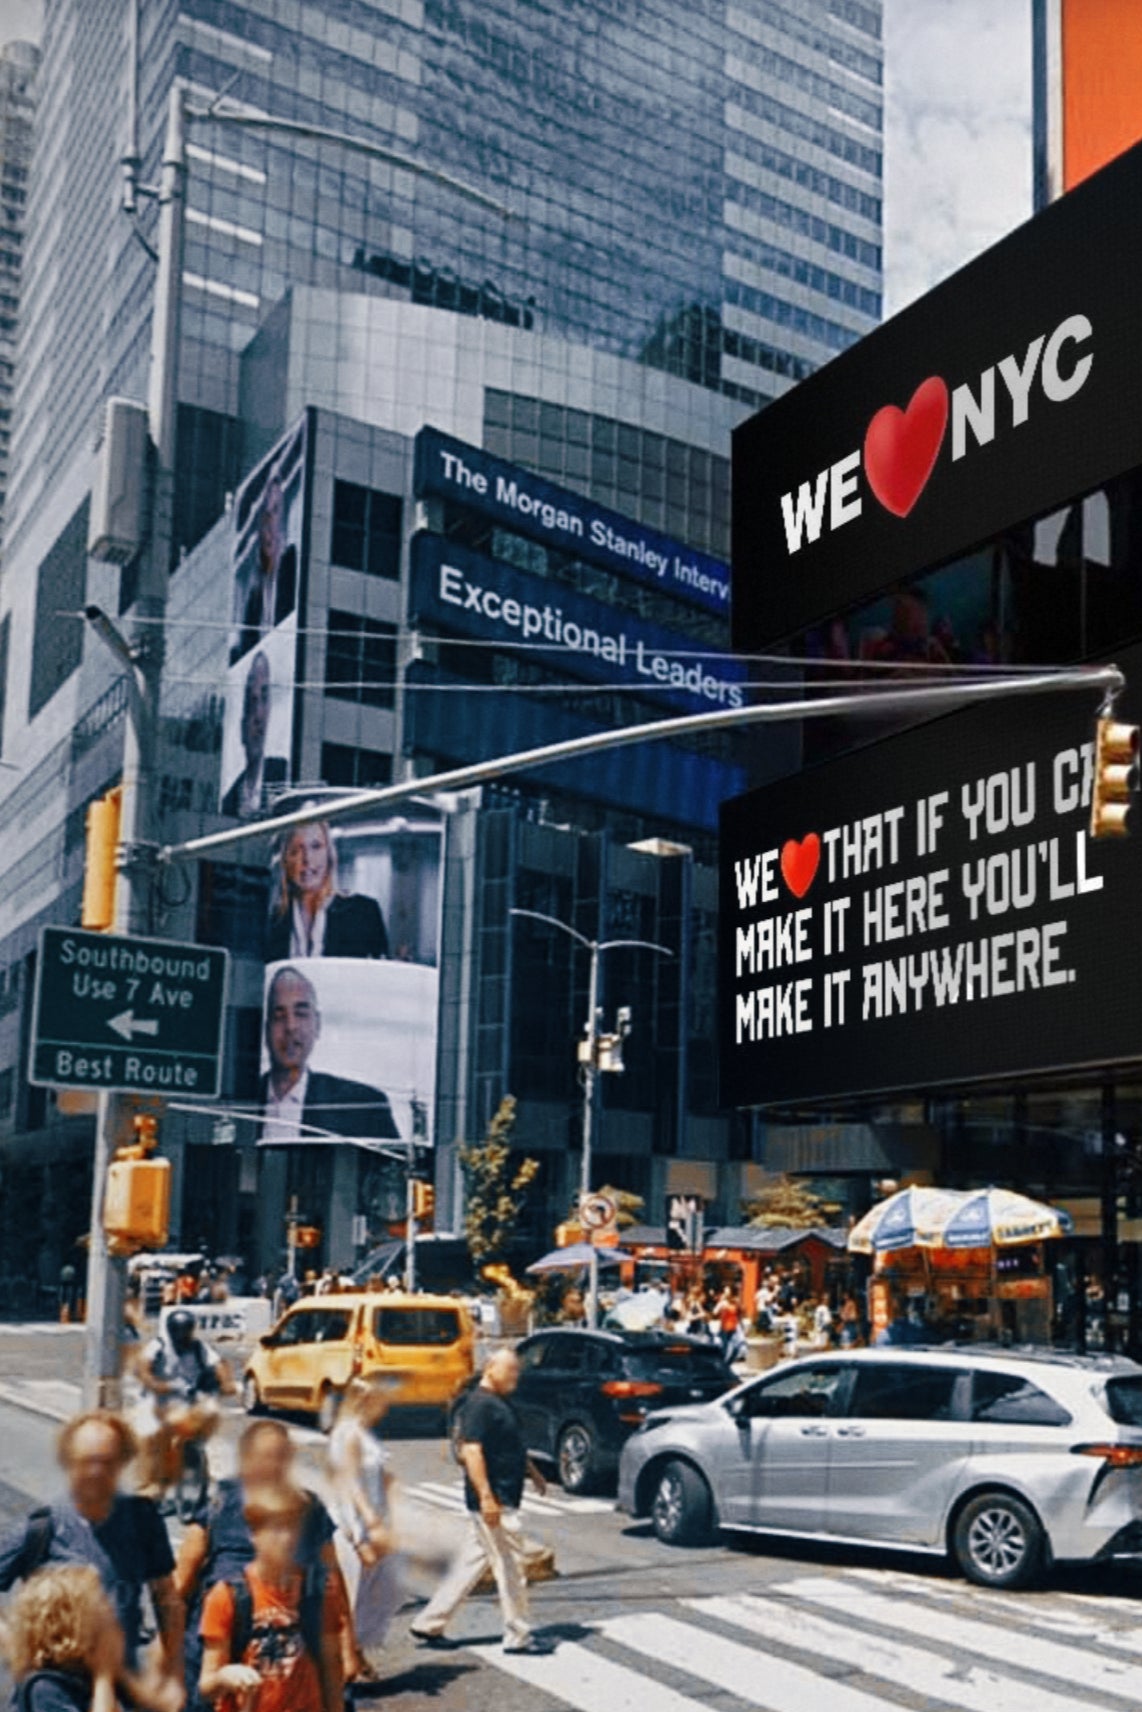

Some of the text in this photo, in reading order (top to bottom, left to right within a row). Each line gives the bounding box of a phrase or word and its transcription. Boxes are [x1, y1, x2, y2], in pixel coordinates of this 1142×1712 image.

[781, 314, 1094, 554] WE NYC
[439, 451, 488, 493] The
[496, 476, 583, 536] Morgan
[590, 520, 668, 577] Stanley
[439, 563, 744, 709] Exceptional Leaders
[735, 742, 1096, 910] WE THAT IF YOU CA
[60, 939, 211, 981] Southbound
[735, 829, 1104, 978] MAKE IT HERE YOU'LL
[73, 972, 194, 1008] Use 7 Ave
[735, 920, 1077, 1045] MAKE IT ANYWHERE.
[56, 1051, 198, 1086] Best Route
